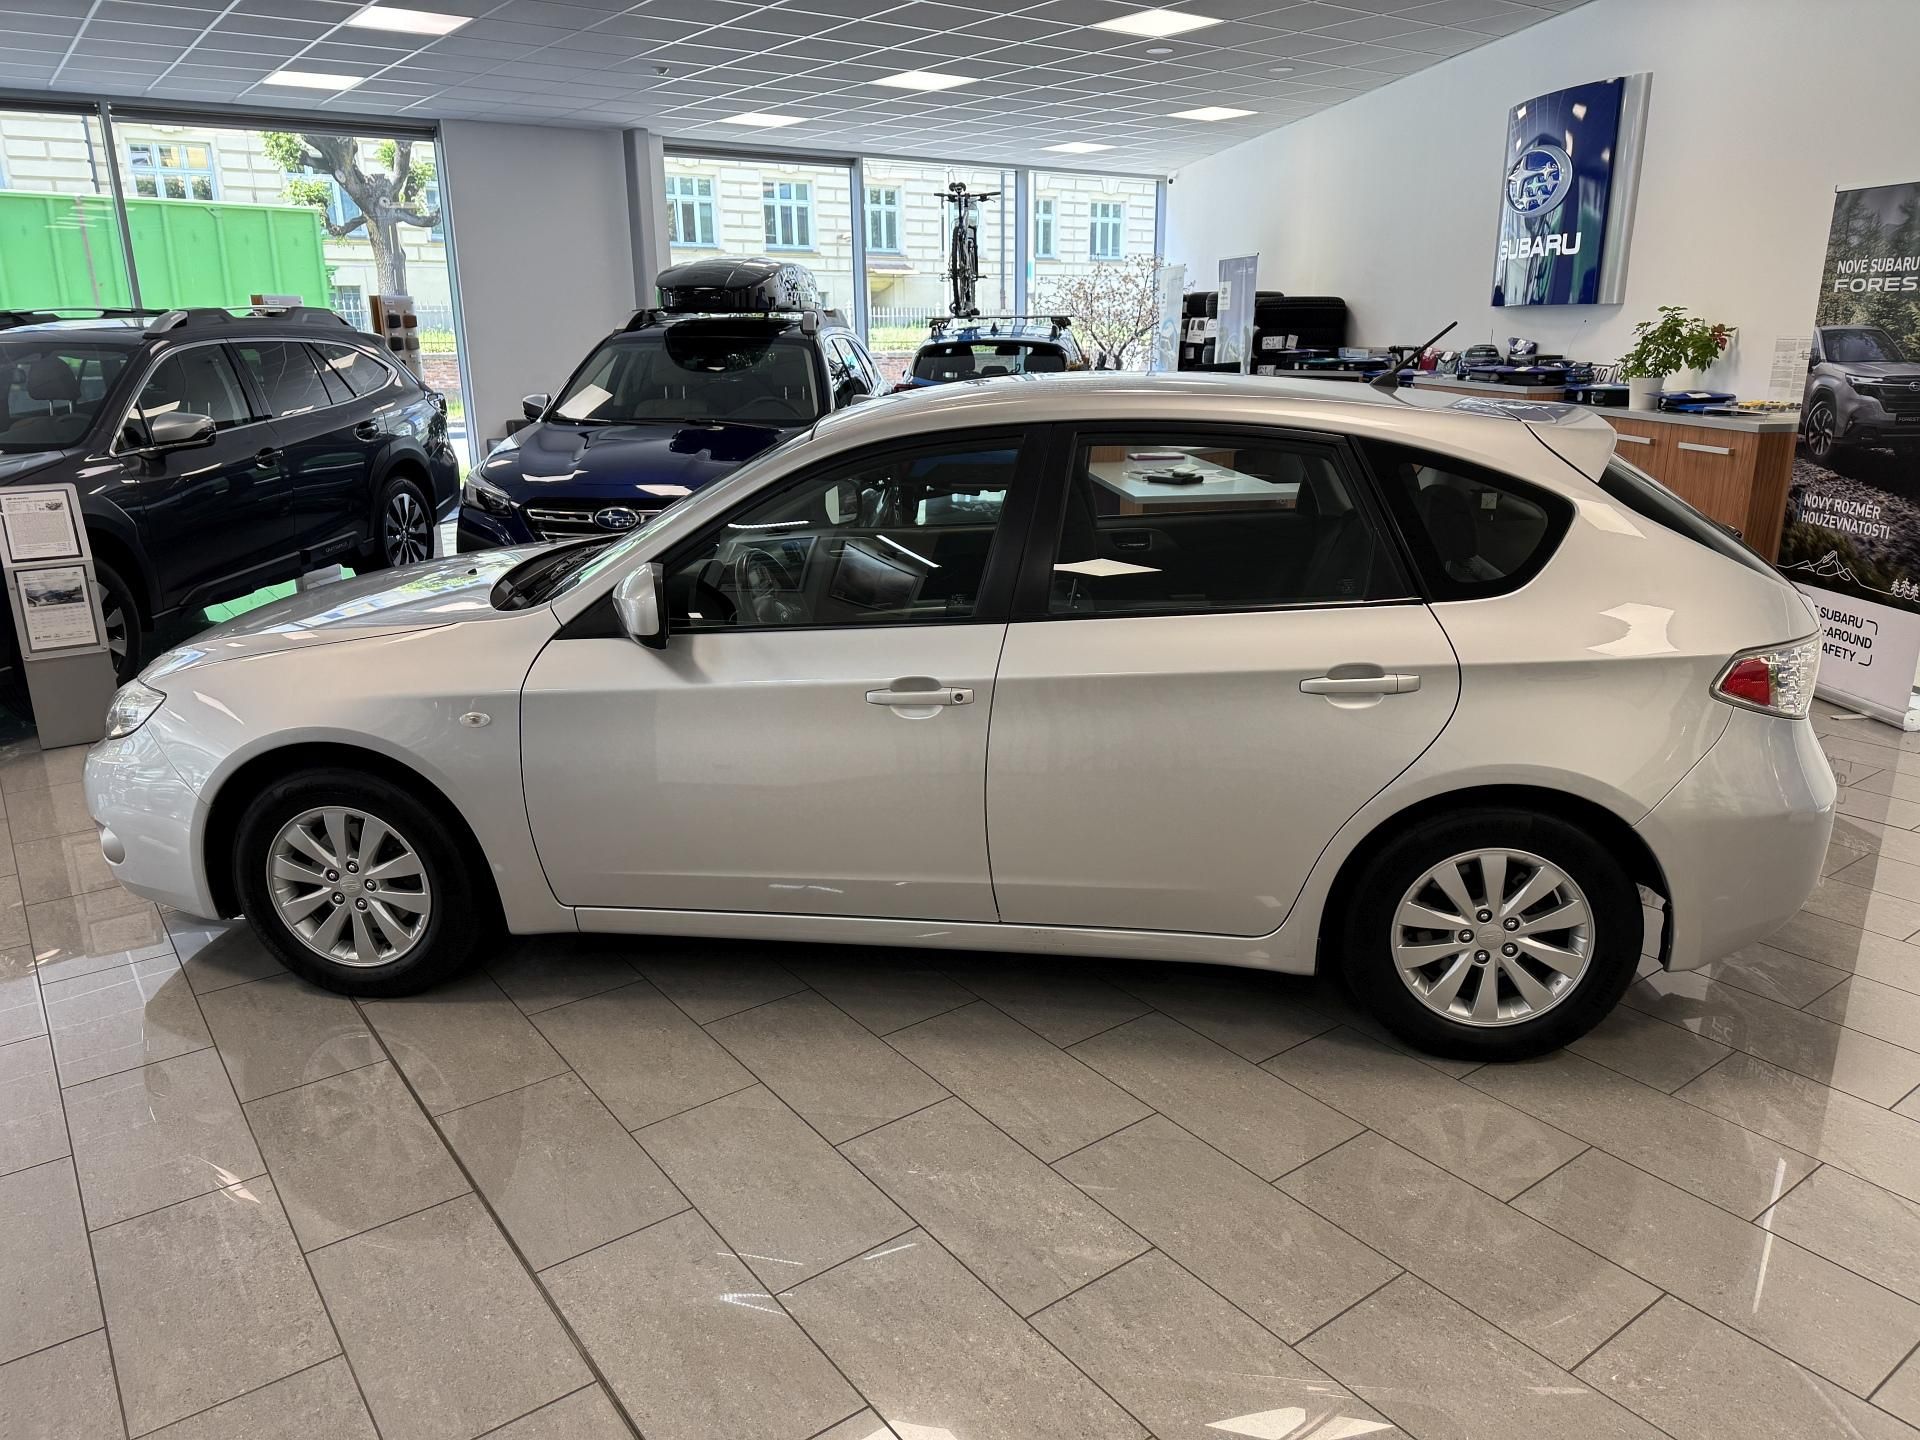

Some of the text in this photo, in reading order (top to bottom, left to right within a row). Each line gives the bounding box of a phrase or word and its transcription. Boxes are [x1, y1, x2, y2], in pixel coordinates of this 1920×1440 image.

[1500, 232, 1582, 260] SUBARU
[1836, 255, 1920, 274] NOVÉ SUBARU
[1803, 493, 1881, 520] NOVÝ ROZMĚR
[1801, 510, 1890, 540] HOUŽEVNATOSTI
[1819, 607, 1864, 629] SUBARU
[1822, 626, 1873, 649] -AROUND
[1821, 642, 1857, 662] AFETY
